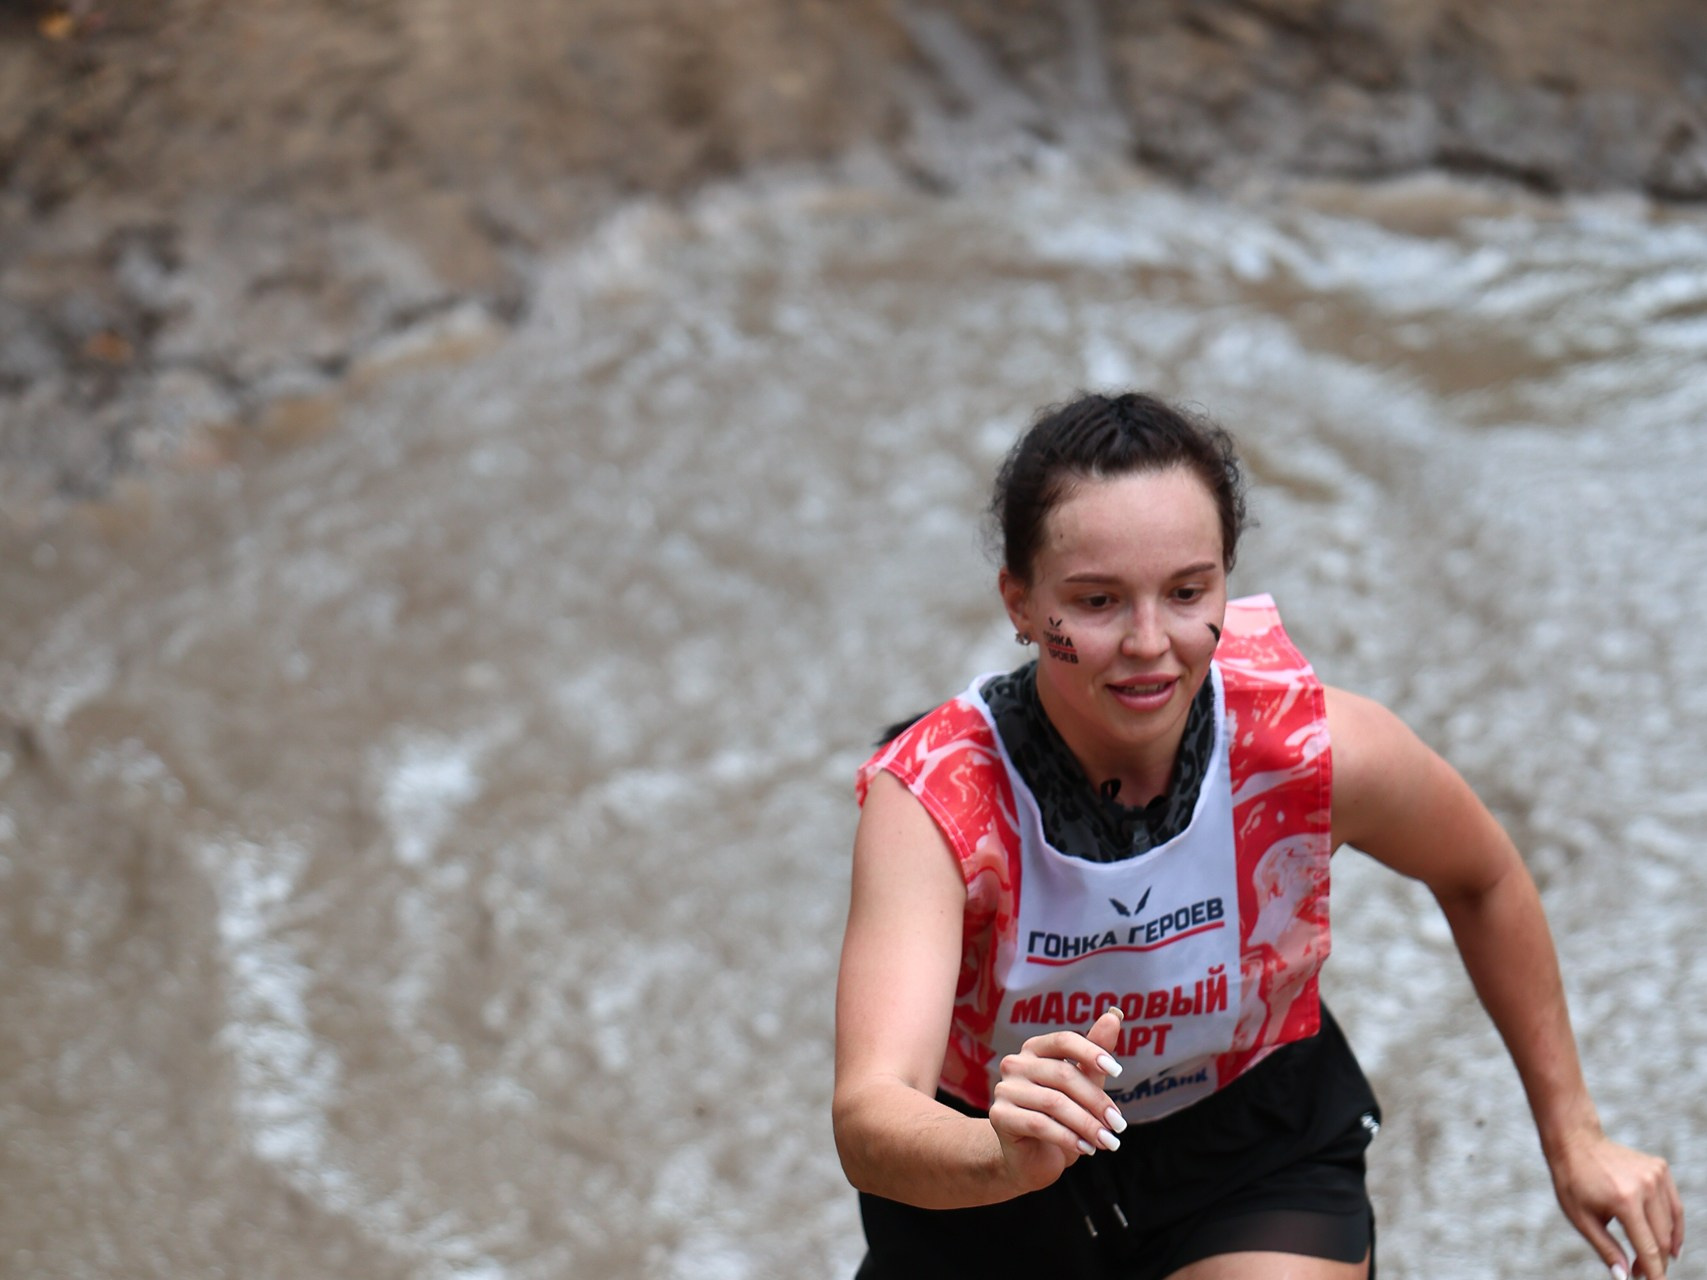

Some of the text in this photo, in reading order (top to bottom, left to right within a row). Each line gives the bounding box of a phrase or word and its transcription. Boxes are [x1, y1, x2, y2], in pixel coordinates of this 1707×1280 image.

[1027, 898, 1224, 957] ГОНКА ГЕРОЕВ
[1010, 965, 1228, 1024] МАССОВЫЙ
[1077, 1024, 1172, 1057] АРТ
